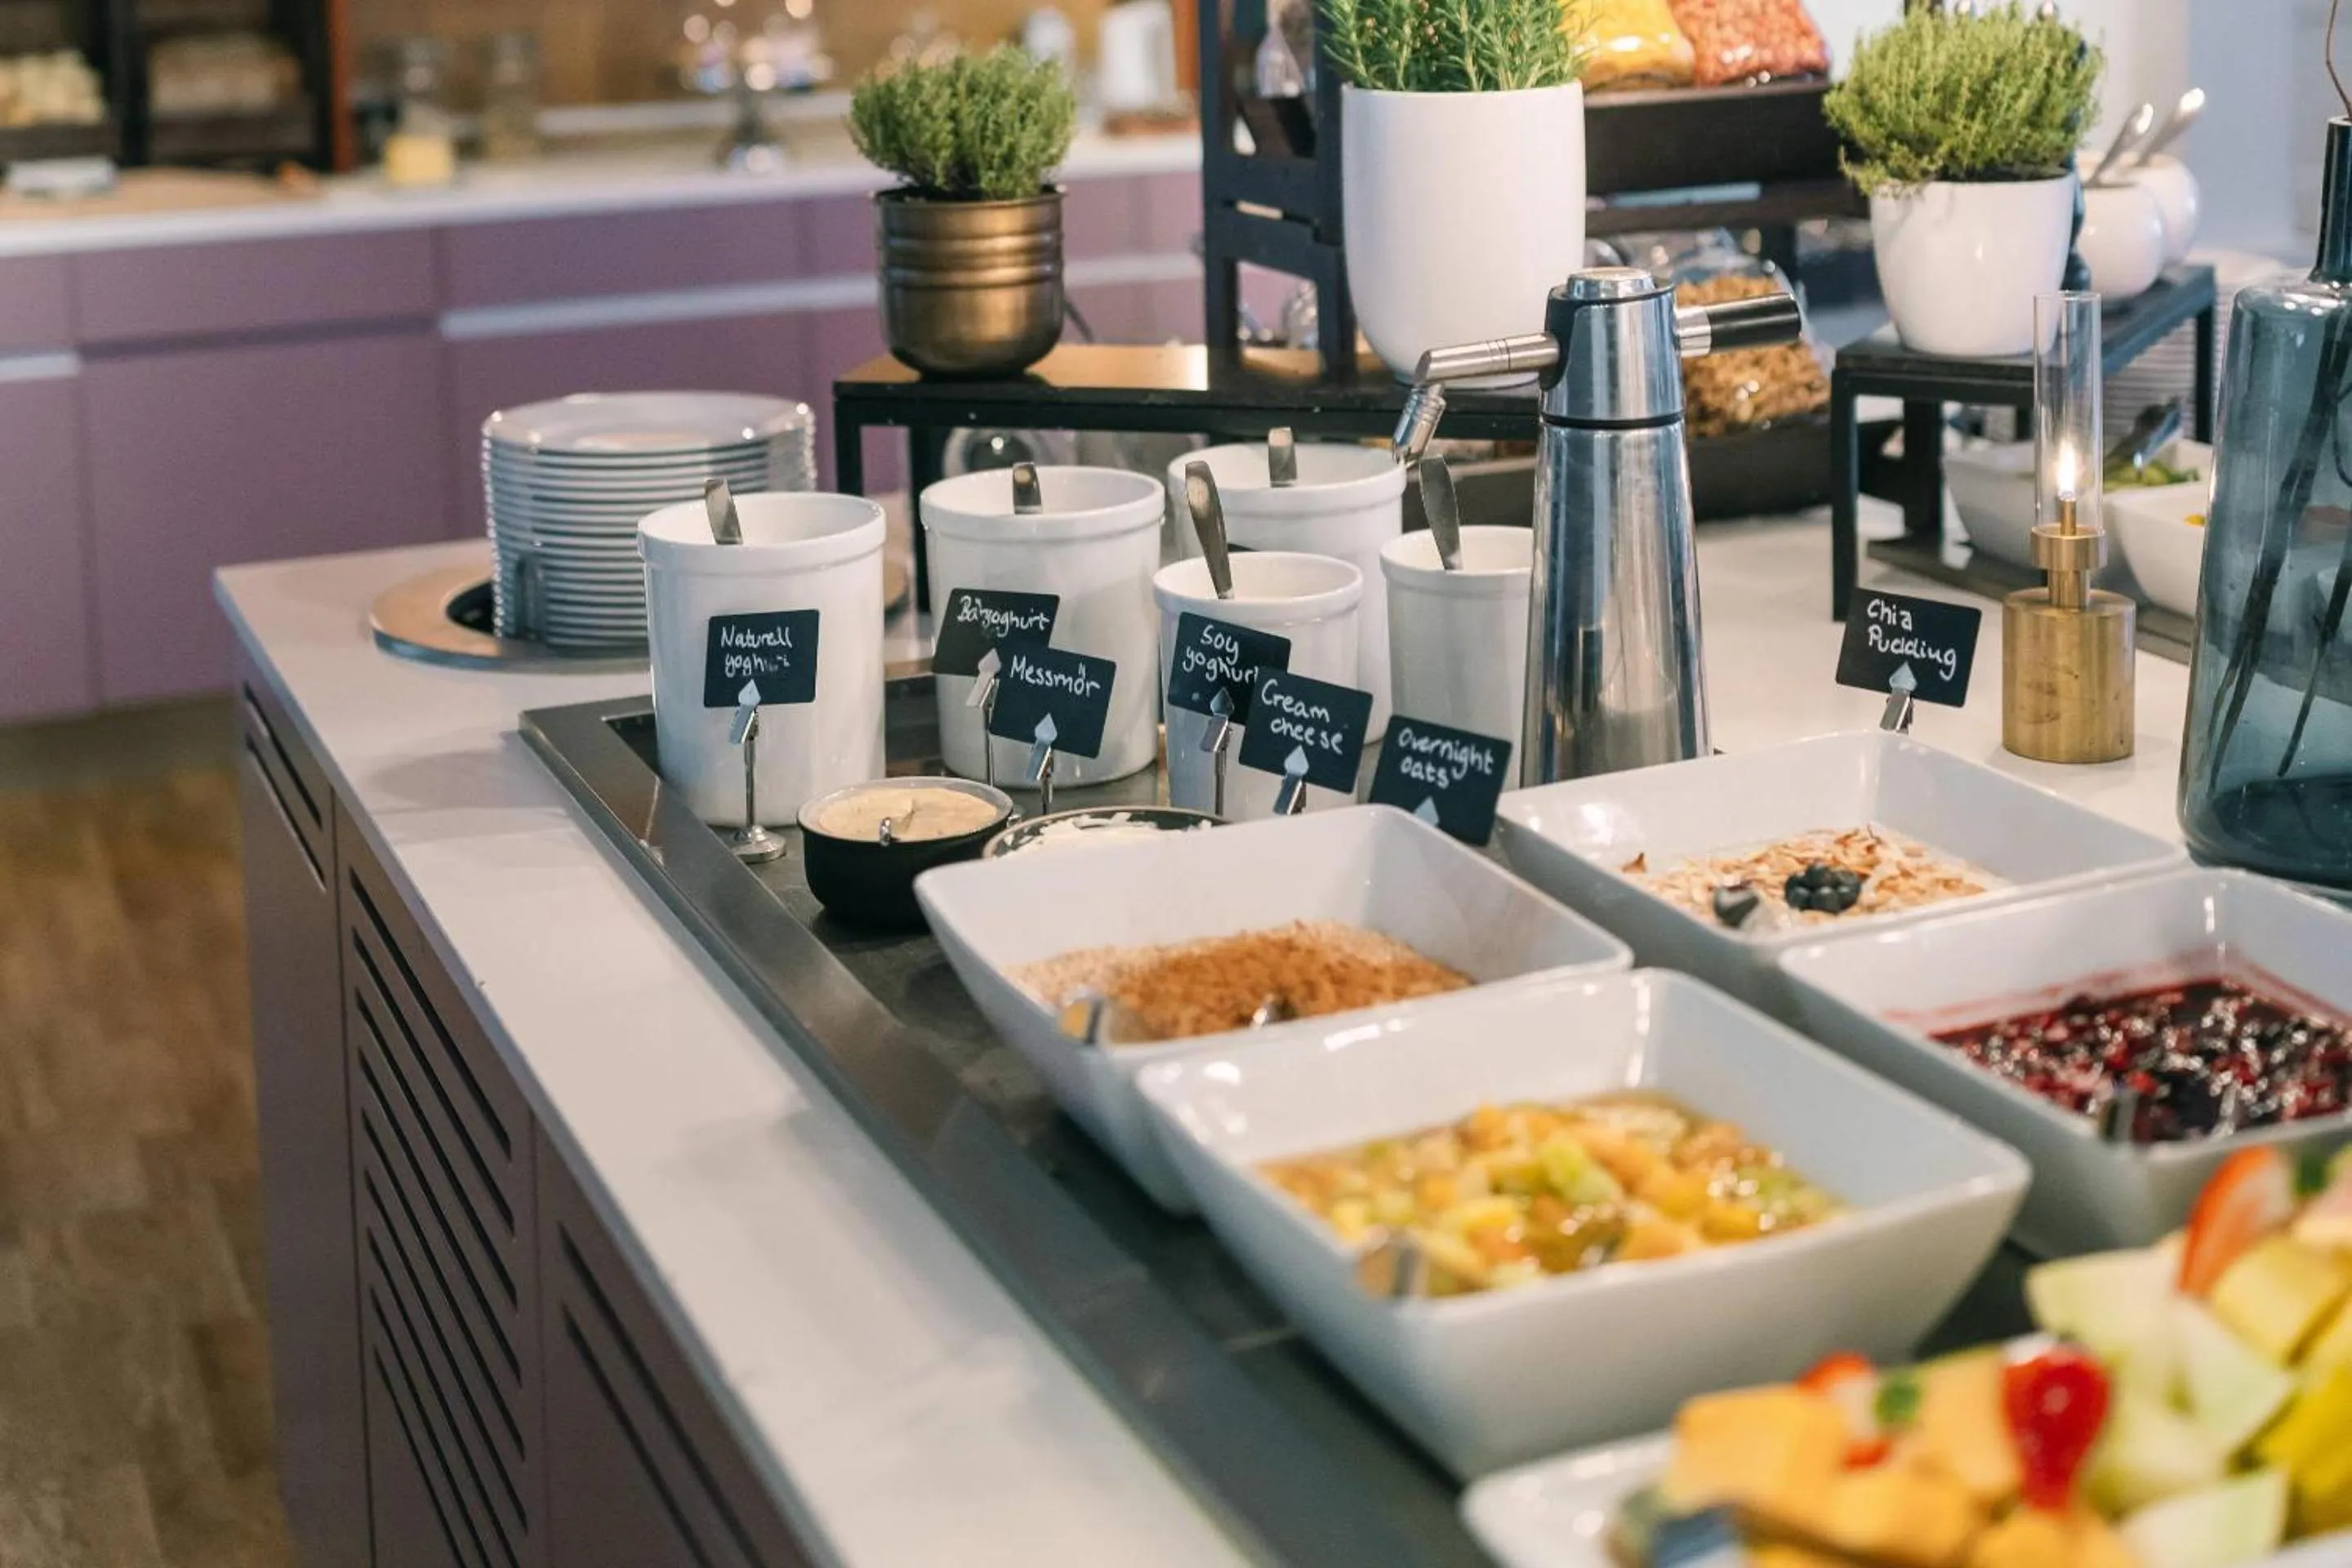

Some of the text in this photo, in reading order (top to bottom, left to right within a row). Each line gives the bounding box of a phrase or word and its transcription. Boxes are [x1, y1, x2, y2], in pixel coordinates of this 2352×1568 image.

[720, 623, 792, 648] Naturell
[1867, 599, 1913, 631] Chia
[1200, 624, 1239, 666] Soy
[1867, 624, 1957, 682] Pudding
[1009, 654, 1102, 697] Messmör
[1261, 679, 1330, 723] Cream
[1271, 717, 1343, 755] cheese
[1398, 727, 1494, 781] Overnight
